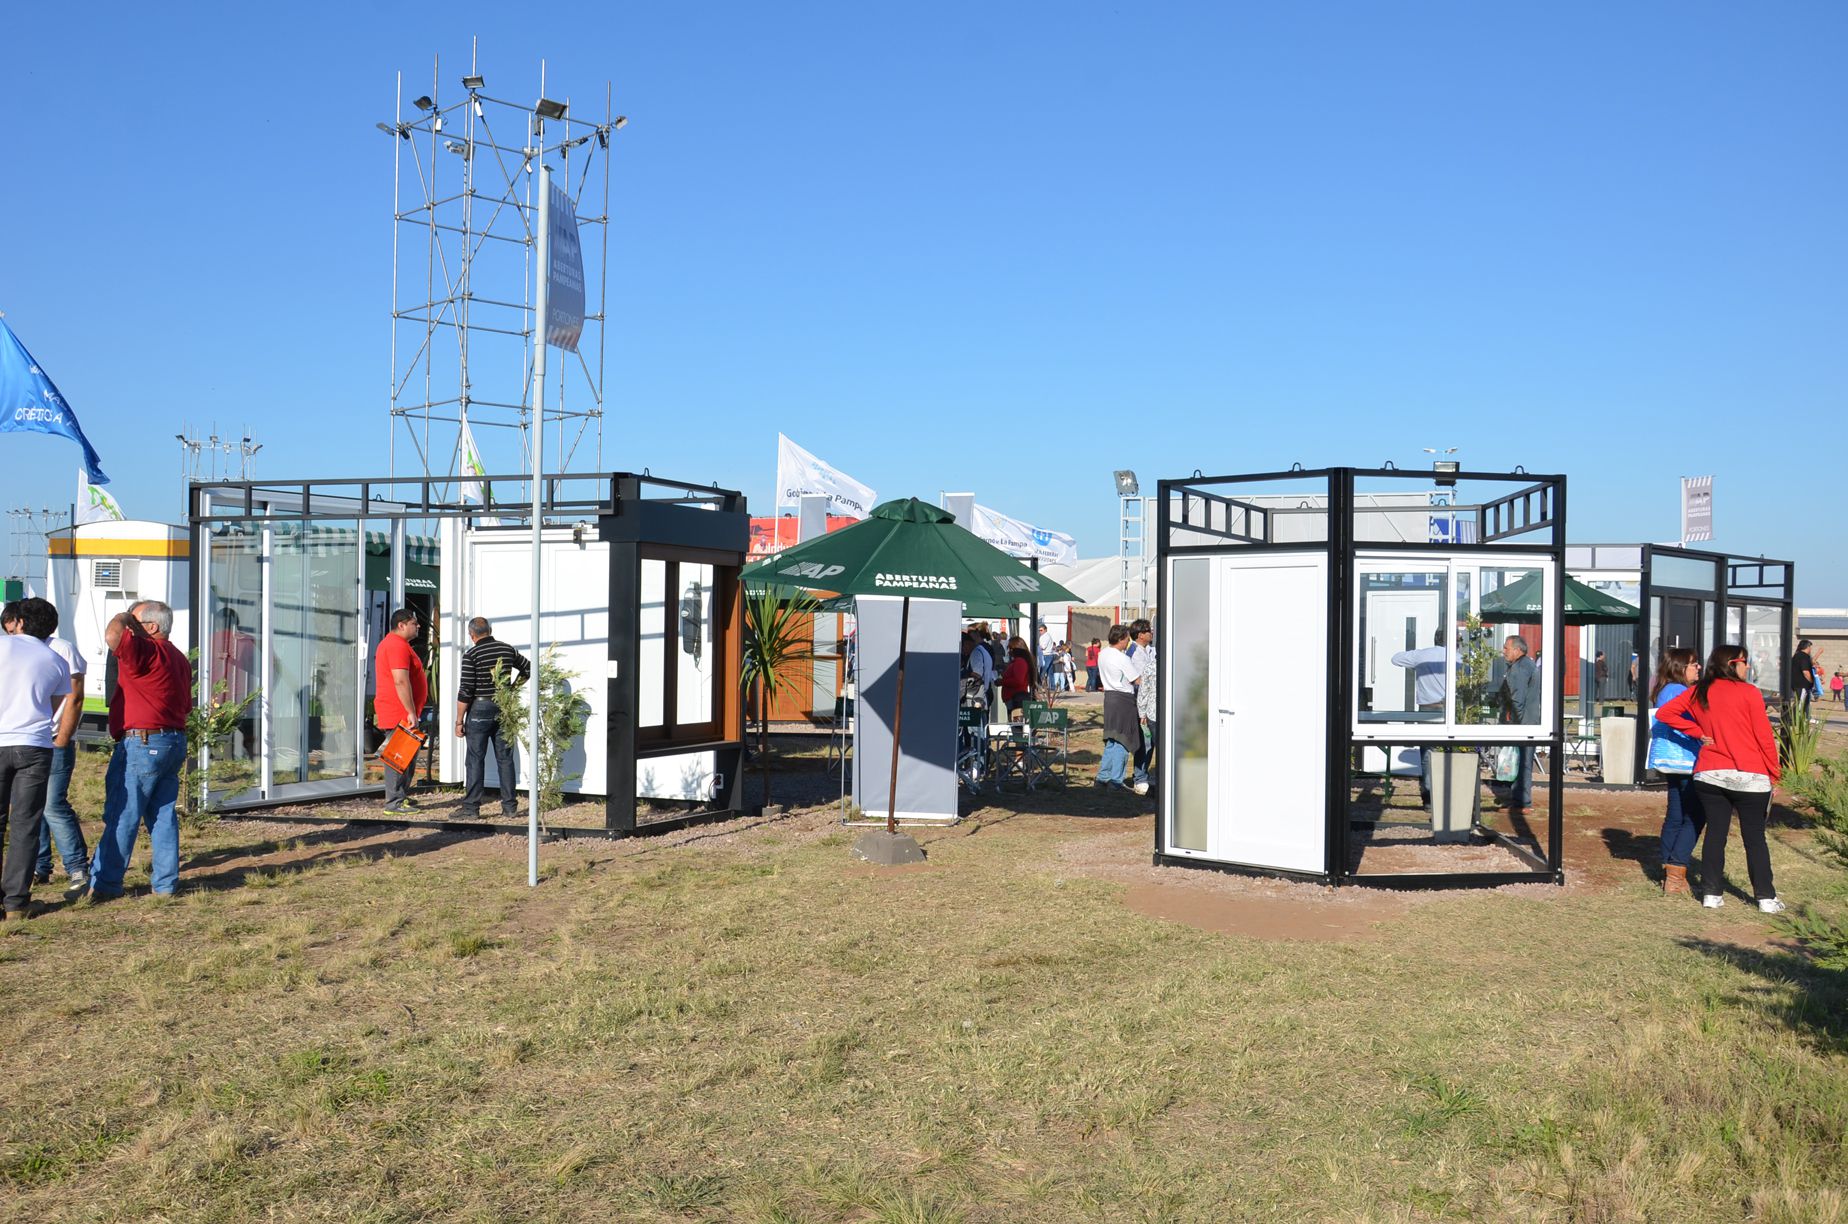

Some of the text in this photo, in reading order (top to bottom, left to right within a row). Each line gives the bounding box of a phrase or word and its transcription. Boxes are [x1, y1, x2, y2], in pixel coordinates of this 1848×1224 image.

[801, 563, 846, 579] AP
[875, 572, 957, 583] ABERTURAS
[875, 580, 958, 590] PAMPEANAS
[1006, 575, 1041, 593] AP
[1044, 712, 1059, 724] AP
